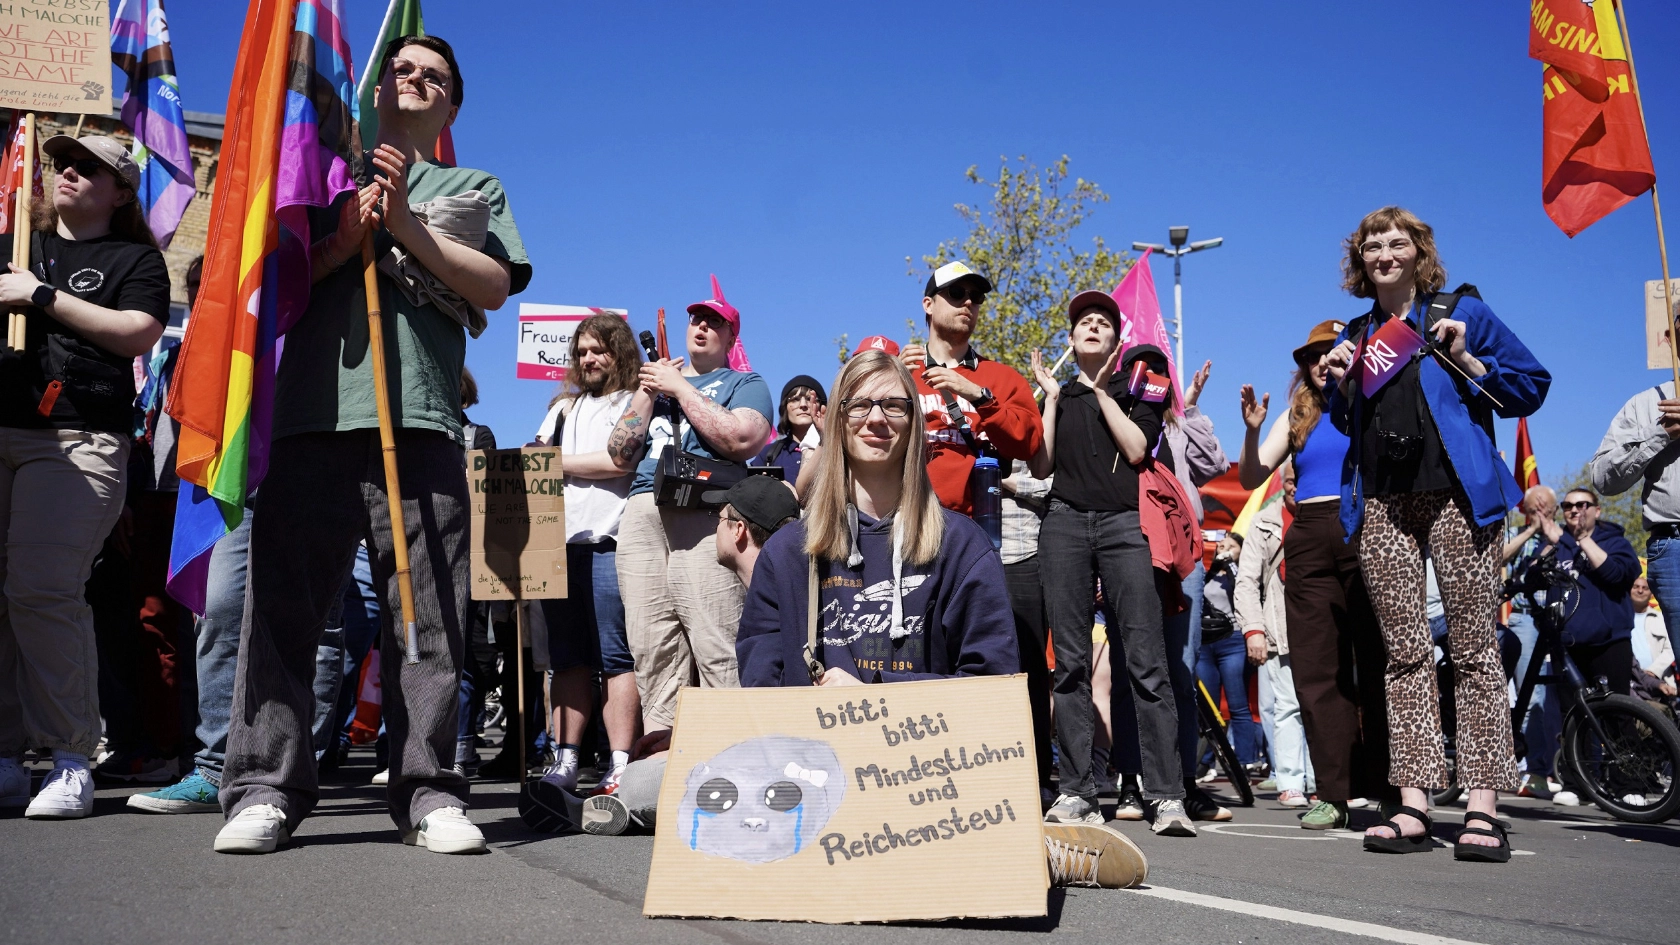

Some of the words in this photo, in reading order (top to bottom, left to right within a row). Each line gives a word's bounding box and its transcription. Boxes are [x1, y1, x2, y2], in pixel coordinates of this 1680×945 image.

[21, 7, 105, 26] MALOCHE
[45, 30, 97, 47] ARE
[0, 40, 36, 59] OT
[42, 46, 95, 64] THE
[33, 91, 59, 99] zieht
[473, 455, 496, 471] DU
[500, 452, 556, 472] ERBST
[475, 479, 501, 494] ICH
[504, 478, 564, 497] MALOCHE
[478, 504, 497, 514] WE
[505, 502, 525, 512] ARE
[495, 517, 512, 525] NOT
[517, 516, 532, 524] THE
[536, 515, 559, 525] SAME
[478, 573, 489, 583] die
[491, 586, 500, 594] die
[854, 658, 884, 671] INCE
[816, 698, 889, 730] bitti
[882, 712, 950, 747] bitti
[855, 741, 1025, 791] Mindestlohni
[908, 777, 959, 806] und
